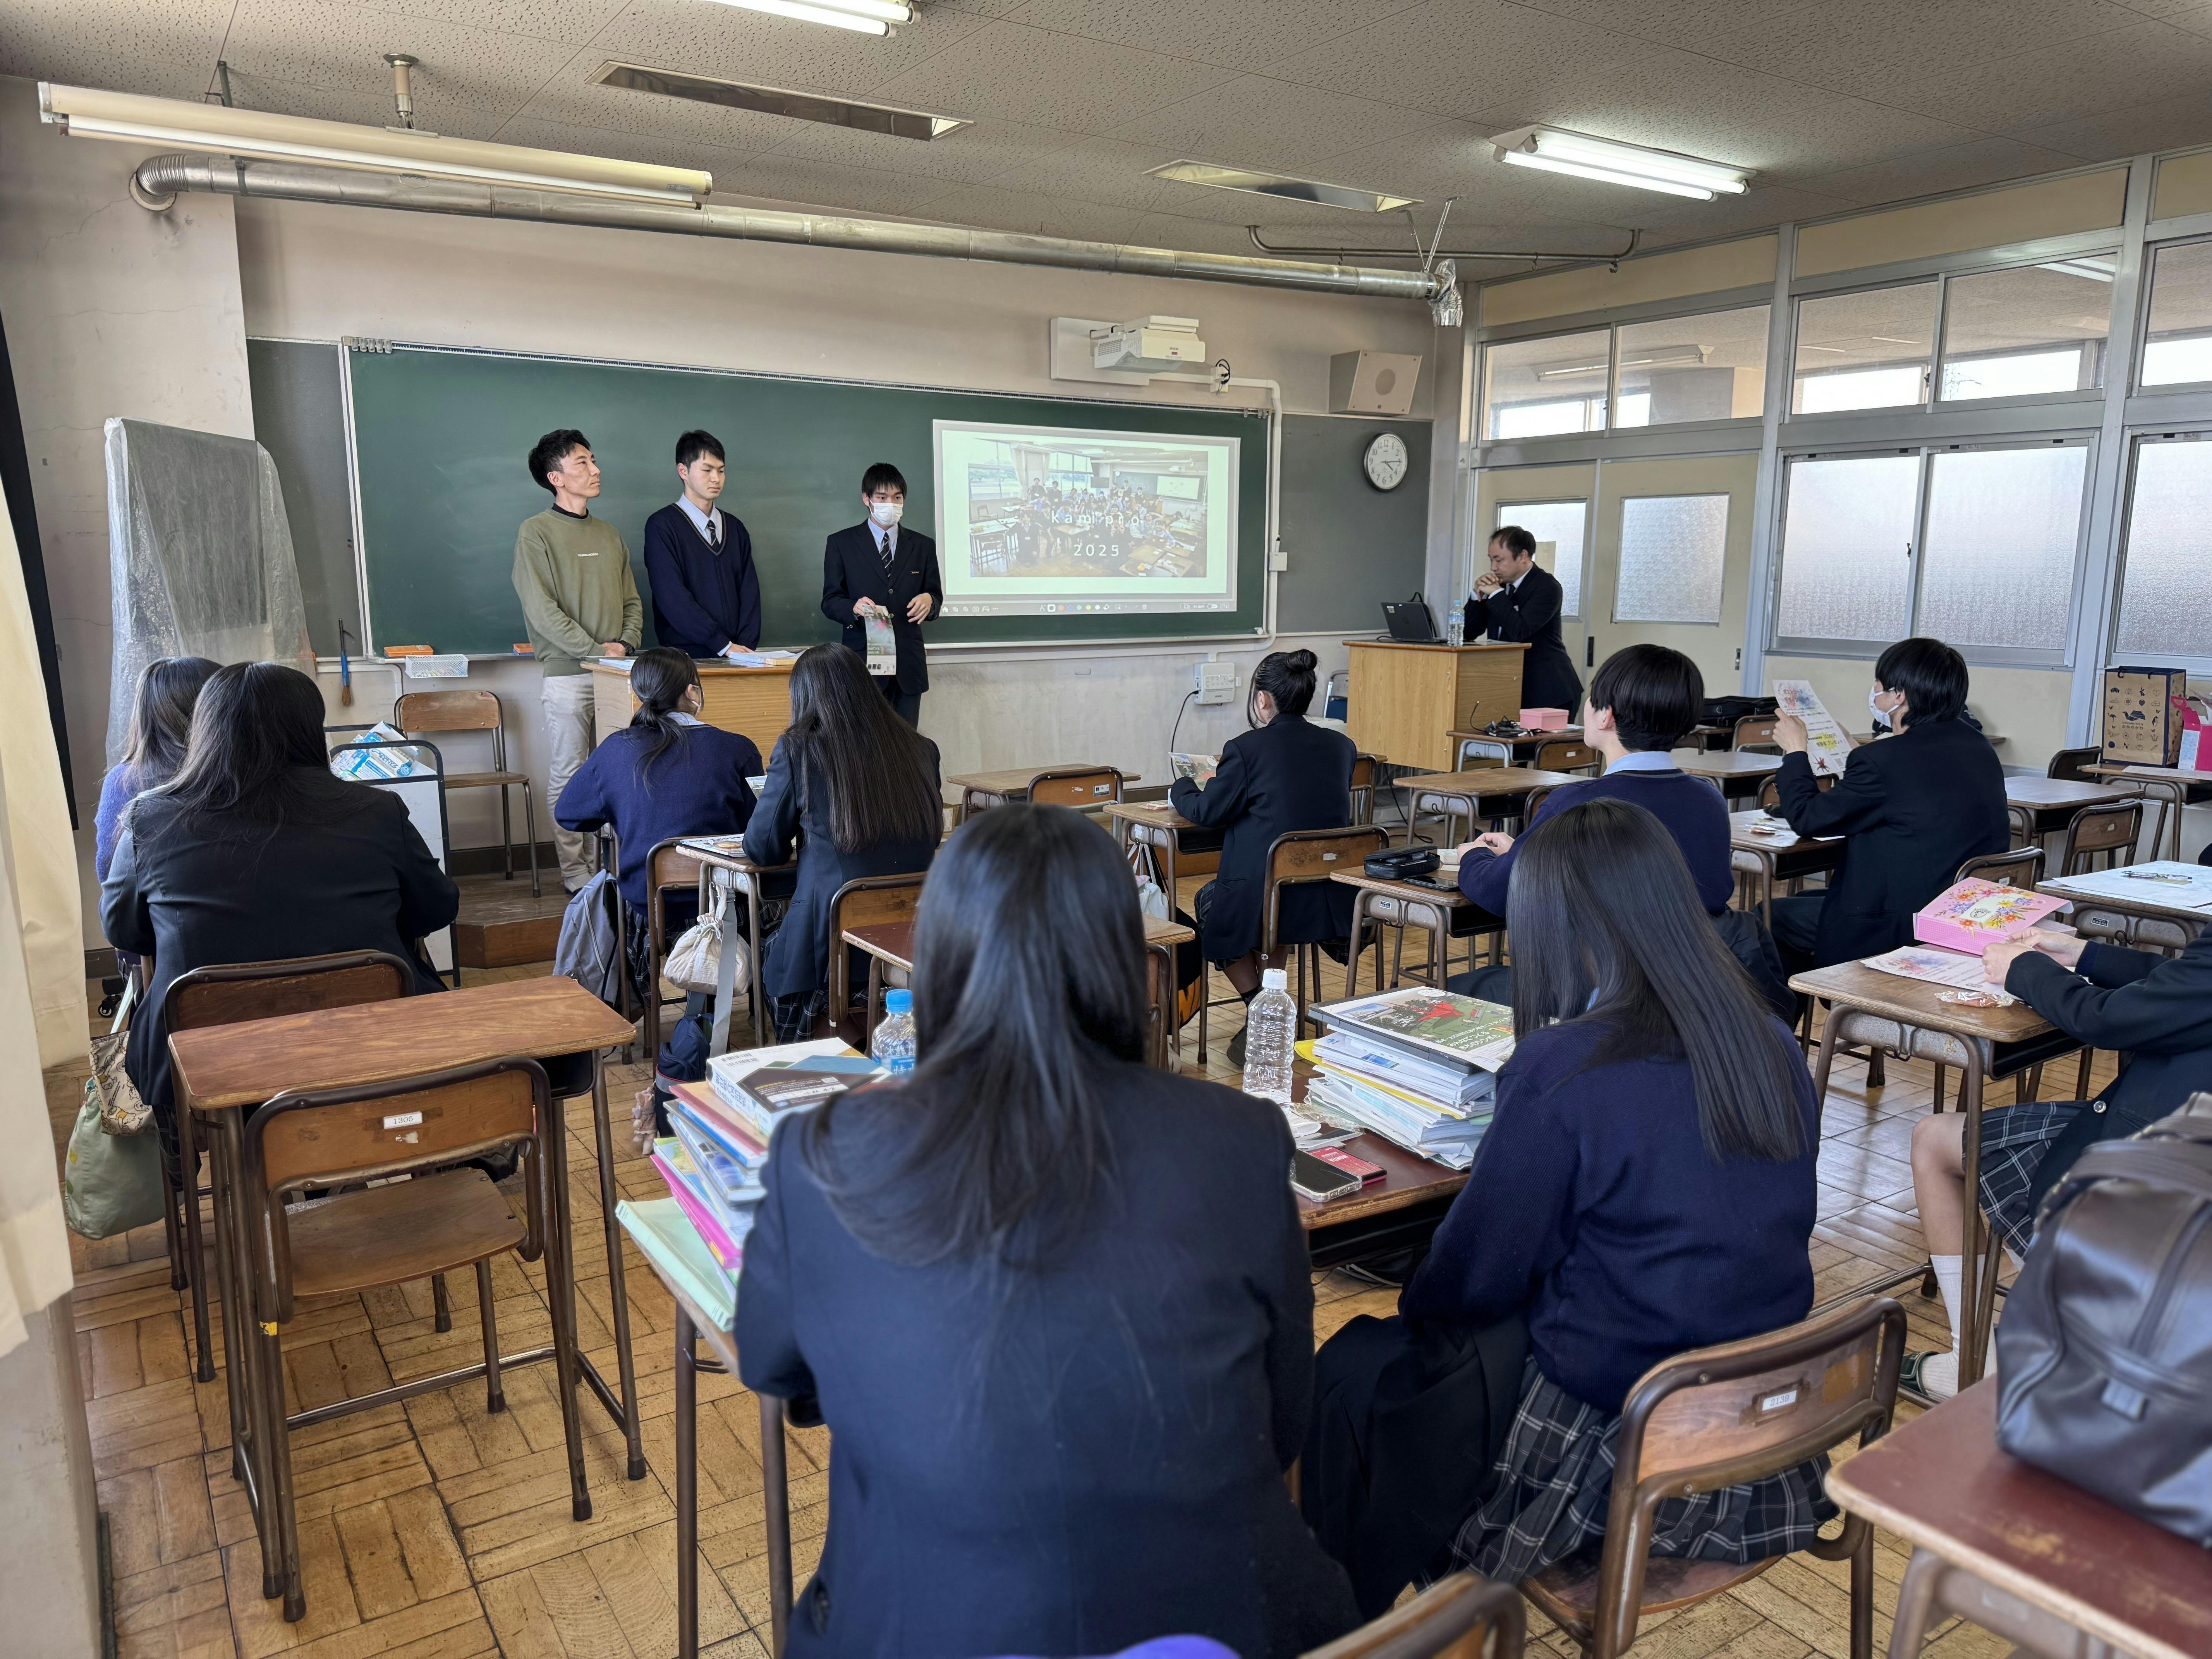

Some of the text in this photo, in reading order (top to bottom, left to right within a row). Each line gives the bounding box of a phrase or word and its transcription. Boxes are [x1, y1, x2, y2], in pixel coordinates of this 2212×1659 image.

[1393, 467, 1398, 476] 4
[1073, 544, 1120, 557] 2025
[393, 1116, 413, 1124] 1305
[1770, 1394, 1790, 1407] 2139
